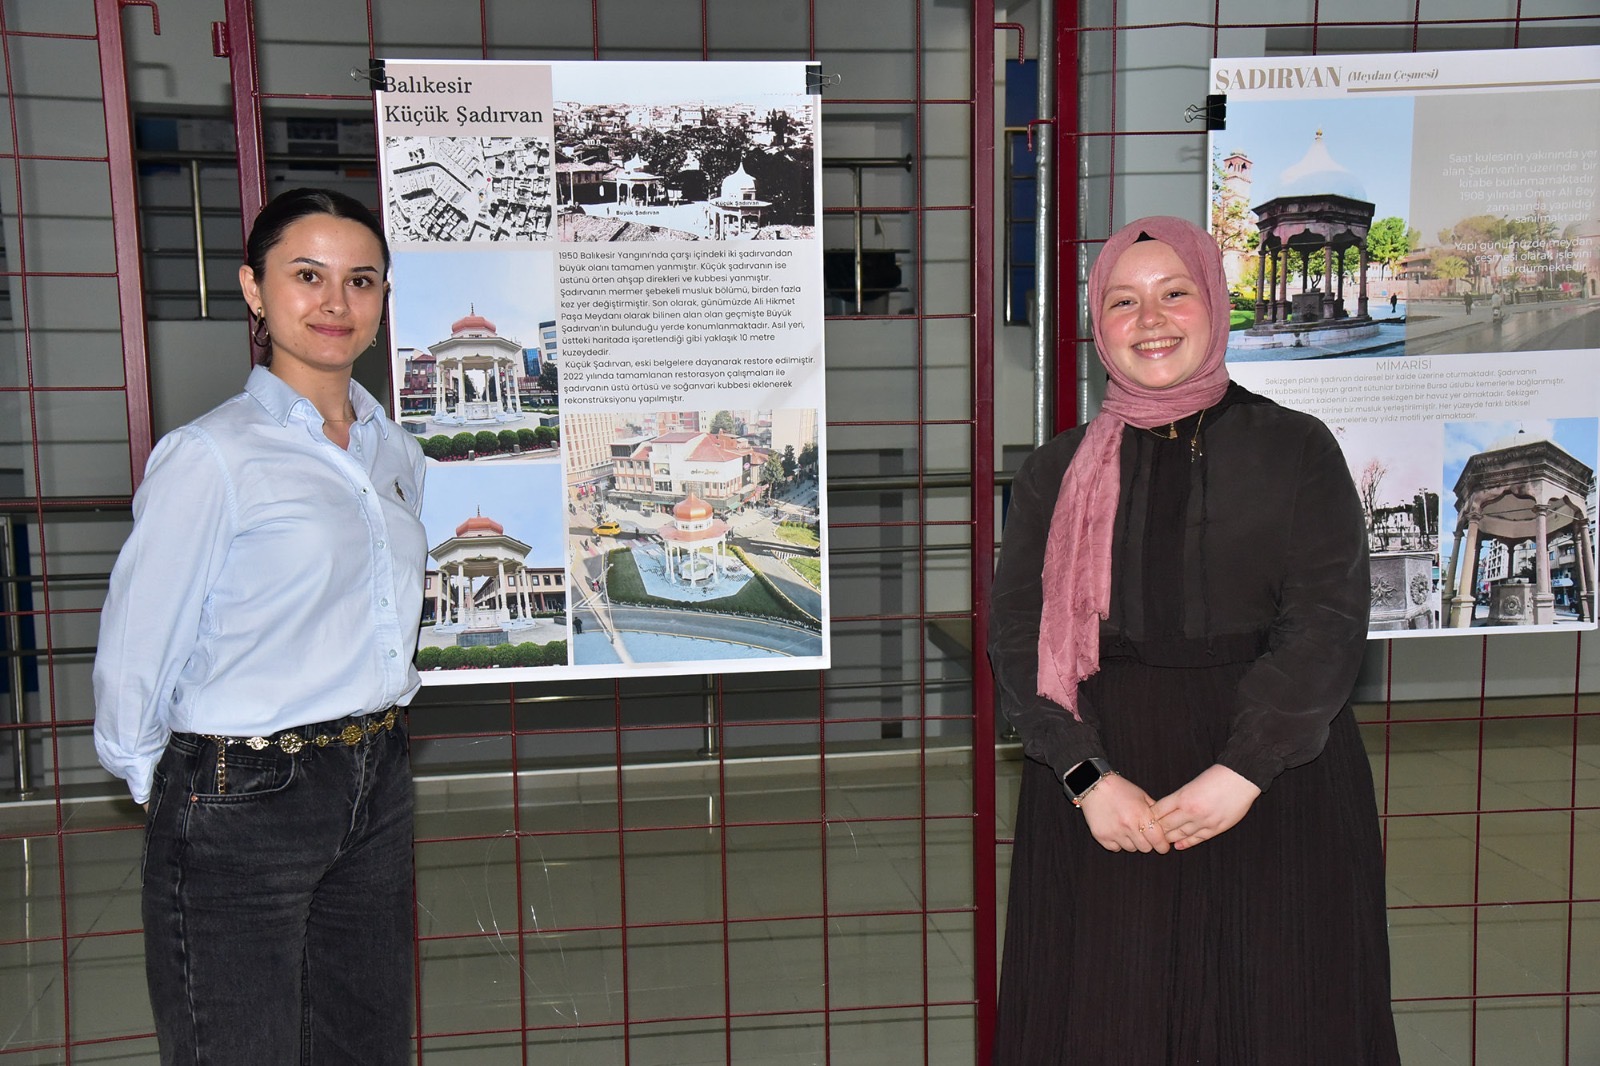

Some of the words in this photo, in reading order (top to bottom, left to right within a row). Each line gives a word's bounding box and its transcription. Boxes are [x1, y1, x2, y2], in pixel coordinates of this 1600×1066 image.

[1348, 71, 1391, 83] (Meydan
[1394, 68, 1438, 82] Çeşmesi)
[384, 76, 472, 93] Balıkesir
[385, 106, 449, 126] Küçük
[457, 106, 543, 126] Şadırvan
[618, 251, 668, 261] Yangını'nda
[671, 251, 691, 260] çarşı
[694, 250, 725, 259] içindeki
[739, 250, 792, 259] şadırvandan
[560, 264, 585, 273] büyük
[657, 264, 698, 272] yanmıştır.
[701, 263, 726, 271] Küçük
[729, 262, 772, 271] şadırvanın
[617, 276, 644, 285] ahşap
[646, 275, 680, 283] direkleri
[730, 274, 771, 283] yanmıştır.
[560, 288, 606, 297] Şadırvanın
[646, 287, 680, 296] şebekeli
[715, 286, 749, 294] bölümü,
[561, 300, 574, 308] kez
[577, 301, 589, 309] yer
[593, 300, 650, 309] değiştirmiştir.
[701, 299, 751, 308] günümüzde
[561, 313, 582, 321] Paşa
[585, 312, 621, 321] Meydanı
[725, 310, 764, 319] geçmişte
[767, 309, 791, 318] Büyük
[562, 325, 609, 334] Şadırvan'ın
[612, 324, 658, 333] bulunduğu
[660, 324, 684, 332] yerde
[687, 322, 769, 330] konumlanmaktadır.
[772, 321, 785, 329] Asıl
[788, 321, 805, 330] yeri,
[632, 335, 684, 344] işaretlendiği
[686, 335, 702, 344] gibi
[704, 334, 737, 343] yaklaşık
[563, 349, 610, 357] kuzeydedir.
[594, 360, 632, 369] Şadırvan,
[654, 359, 693, 368] belgelere
[696, 358, 741, 366] dayanarak
[775, 357, 815, 365] edilmiştir.
[1376, 358, 1432, 370] MİMARİSİ
[586, 372, 614, 381] yılında
[616, 371, 672, 379] tamamlanan
[675, 370, 725, 378] restorasyon
[727, 369, 773, 378] çalışmaları
[564, 385, 609, 393] şadırvanın
[632, 383, 658, 391] örtüsü
[673, 382, 715, 392] soğanvari
[753, 380, 792, 388] eklenerek
[564, 396, 636, 404] rekonstrüksiyonu
[638, 395, 684, 404] yapılmıştır.
